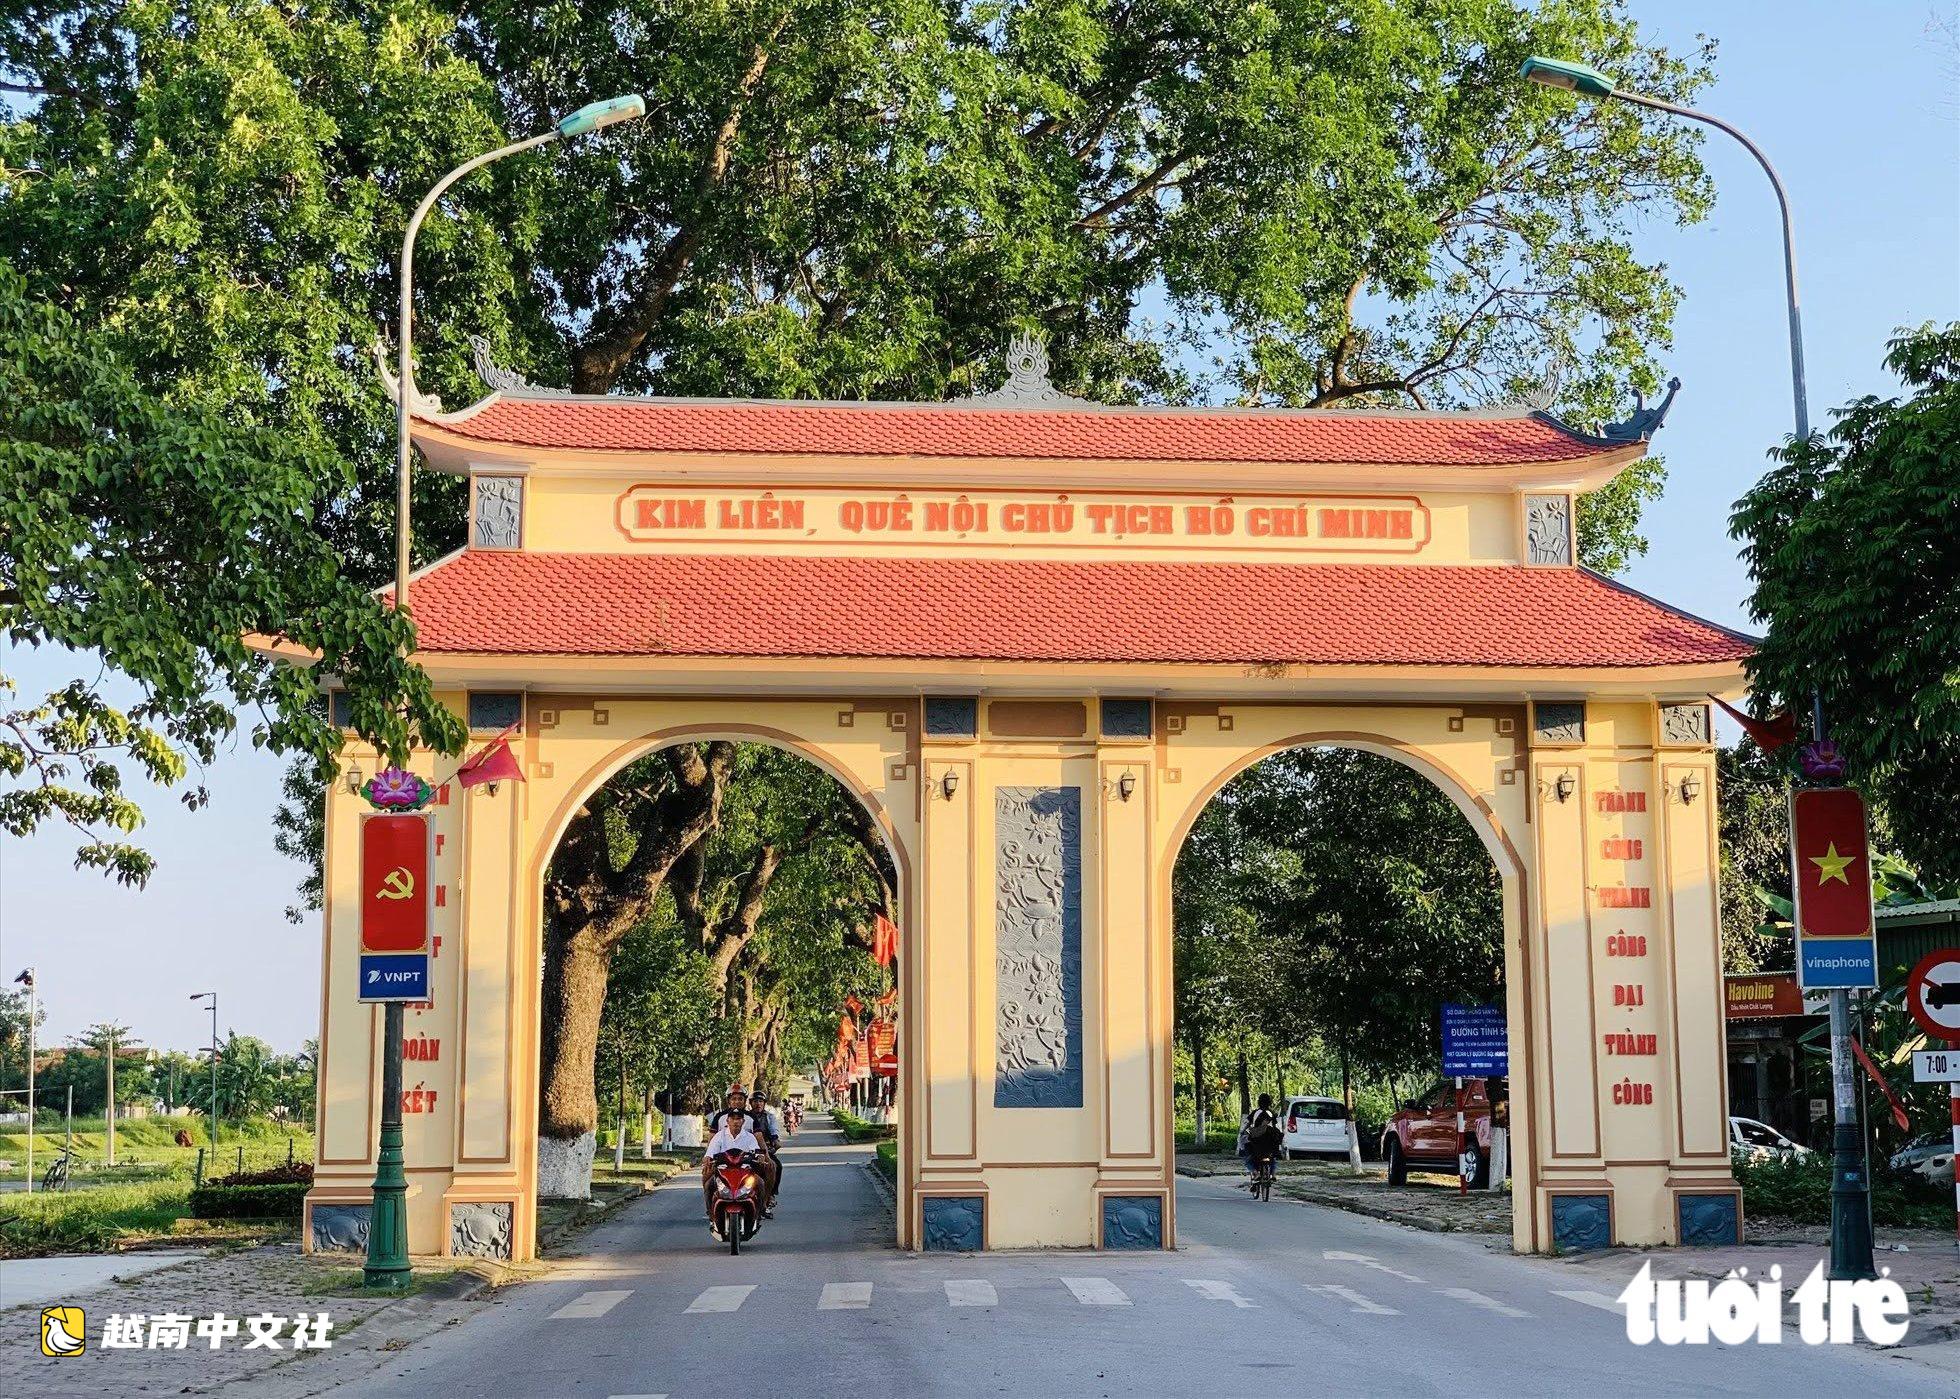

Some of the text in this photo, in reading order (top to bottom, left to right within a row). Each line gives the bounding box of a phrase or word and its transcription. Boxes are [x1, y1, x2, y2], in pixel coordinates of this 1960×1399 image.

[633, 492, 1413, 540] KIM LIÊN, QUÊ NỘI CHỦ TỊCH HỒ CHÍ MINH
[1606, 928, 1647, 957] CÔNG
[1806, 956, 1870, 970] vinaphone
[384, 972, 420, 982] VNPT
[1728, 982, 1774, 1000] Havoline
[1604, 1028, 1657, 1056] THÀNH
[1926, 1055, 1947, 1073] 7:00
[1612, 1077, 1653, 1105] CÔNG
